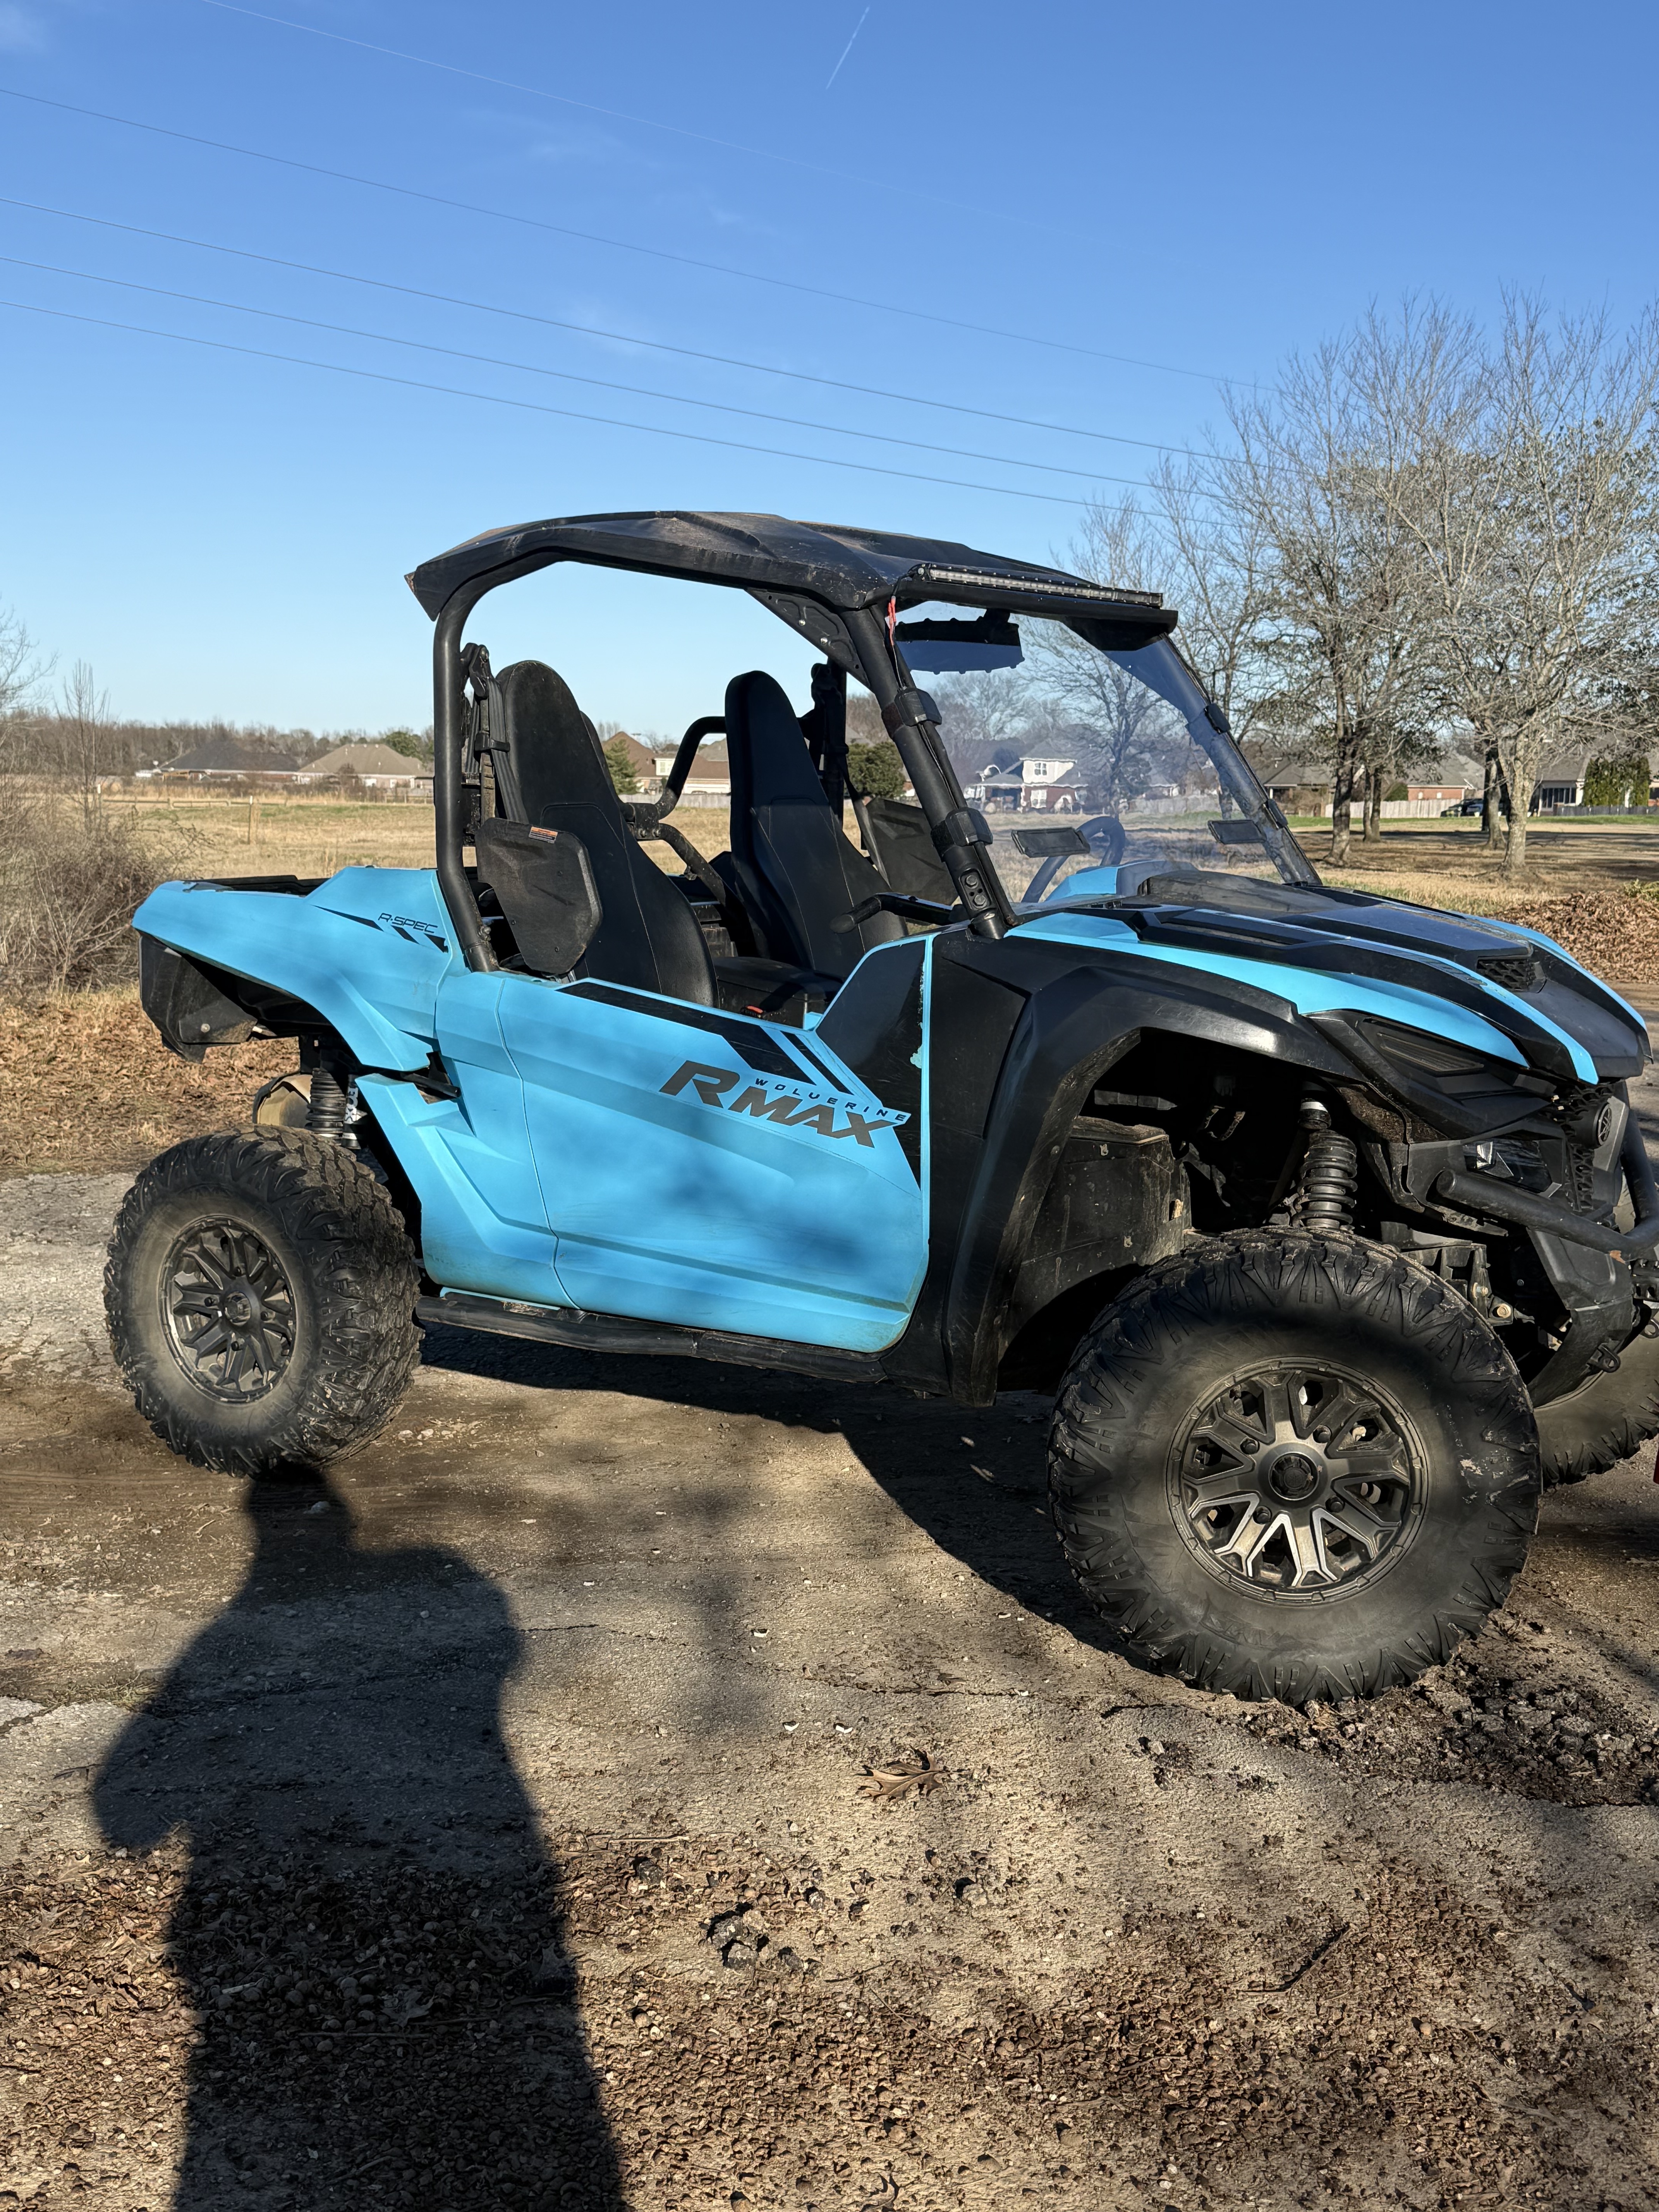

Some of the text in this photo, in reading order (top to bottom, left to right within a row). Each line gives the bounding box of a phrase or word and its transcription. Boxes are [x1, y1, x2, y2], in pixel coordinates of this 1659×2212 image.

[345, 1087, 358, 1124] FOX
[659, 1060, 898, 1148] RMAX
[755, 1078, 906, 1121] WOLVERINE
